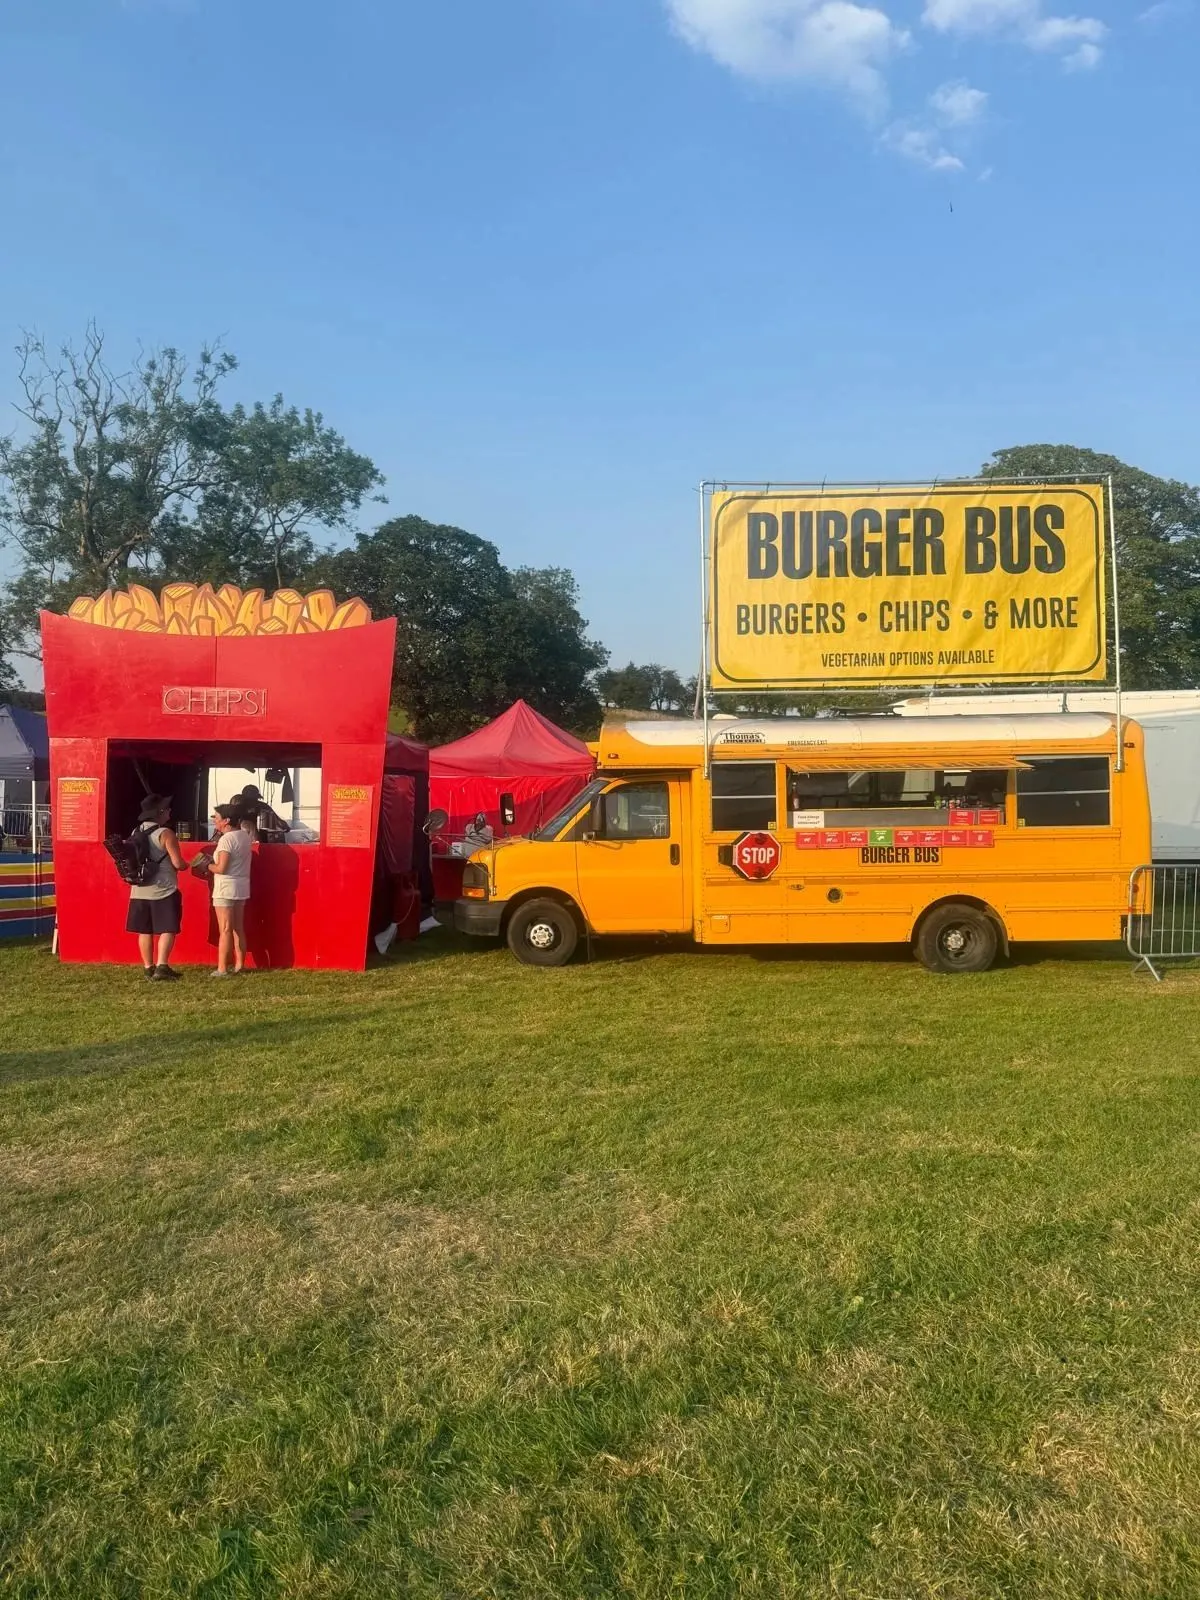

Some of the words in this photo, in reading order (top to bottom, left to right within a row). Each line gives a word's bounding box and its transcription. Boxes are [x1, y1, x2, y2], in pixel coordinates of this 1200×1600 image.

[747, 506, 947, 580] BURGER
[964, 503, 1066, 575] BUS
[736, 602, 846, 636] BURGERS
[879, 599, 950, 633] CHIPS
[984, 600, 999, 630] &
[1010, 596, 1079, 630] MORE
[821, 652, 886, 668] VEGETARIAN
[889, 651, 934, 666] OPTIONS
[937, 649, 995, 665] AVAILABLE
[724, 732, 761, 740] Thomas
[742, 847, 775, 864] STOP
[861, 846, 910, 864] BURGER
[914, 846, 940, 863] BUS
